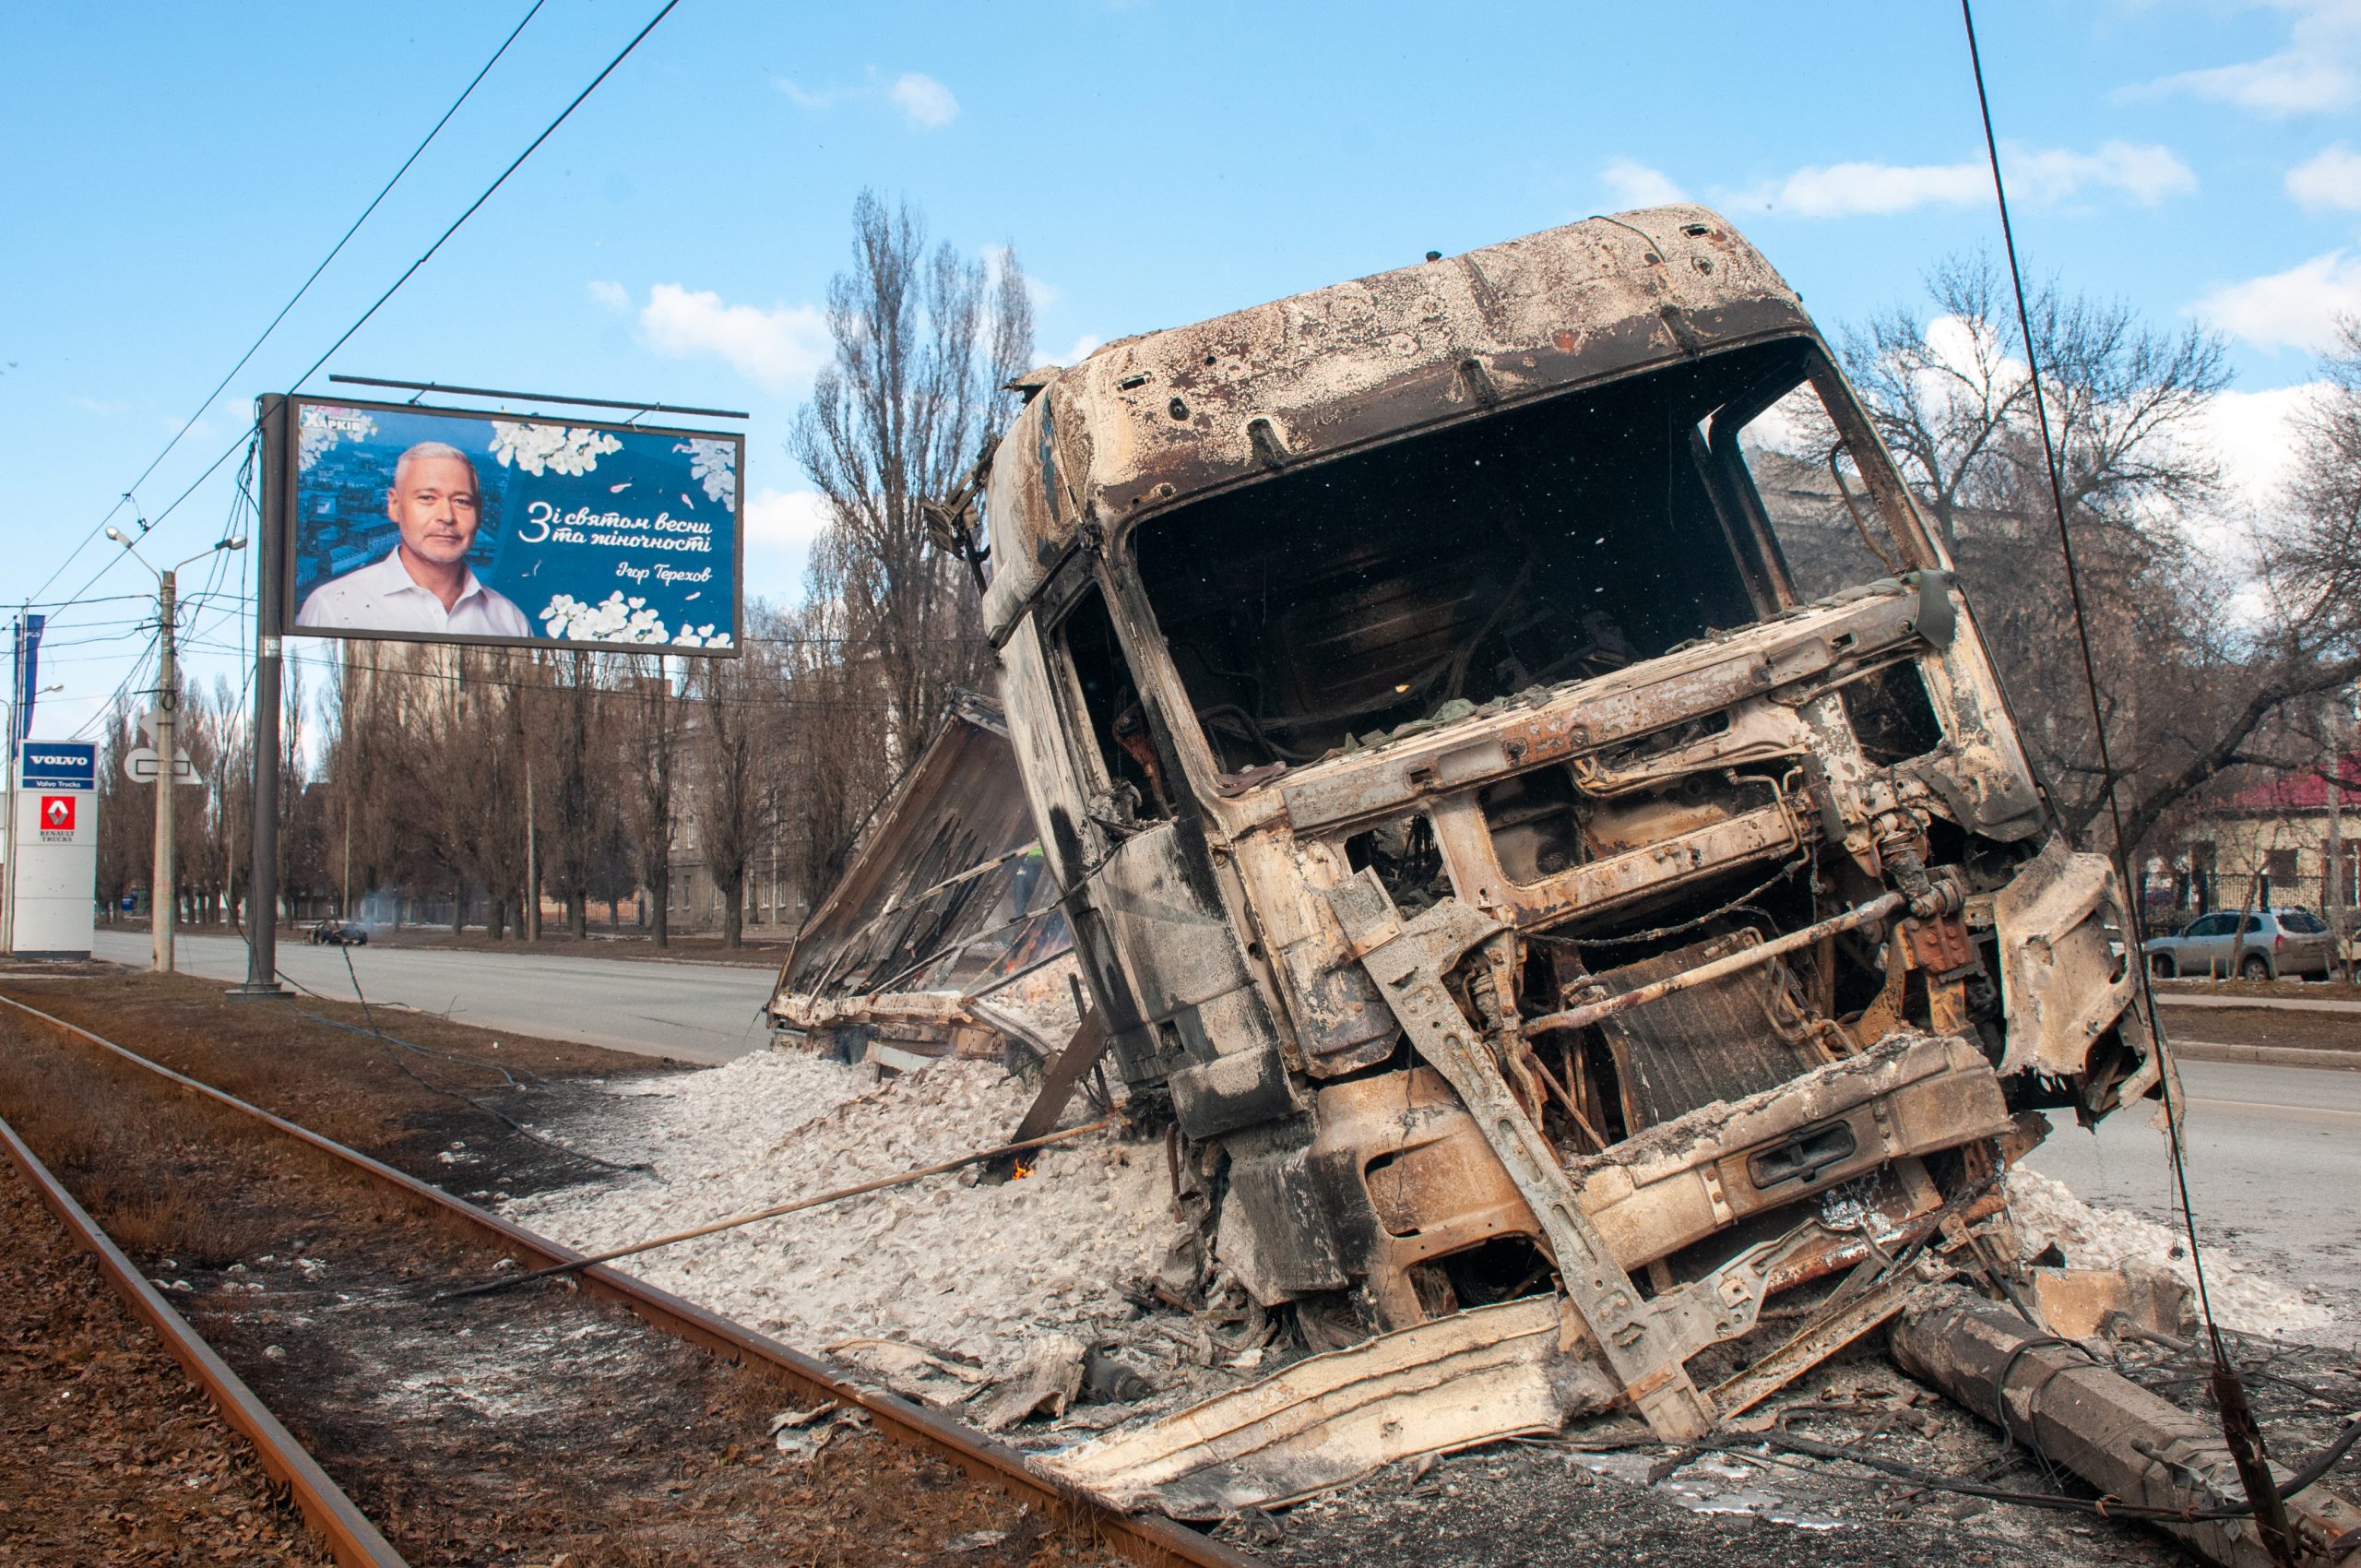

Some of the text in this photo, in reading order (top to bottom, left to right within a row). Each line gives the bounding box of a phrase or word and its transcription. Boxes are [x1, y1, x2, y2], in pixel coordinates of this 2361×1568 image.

[565, 507, 651, 529] святом
[654, 512, 712, 534] весни
[552, 527, 712, 552] та жіночності
[616, 562, 713, 587] Ігор Терехов
[30, 755, 88, 766] VOLVO
